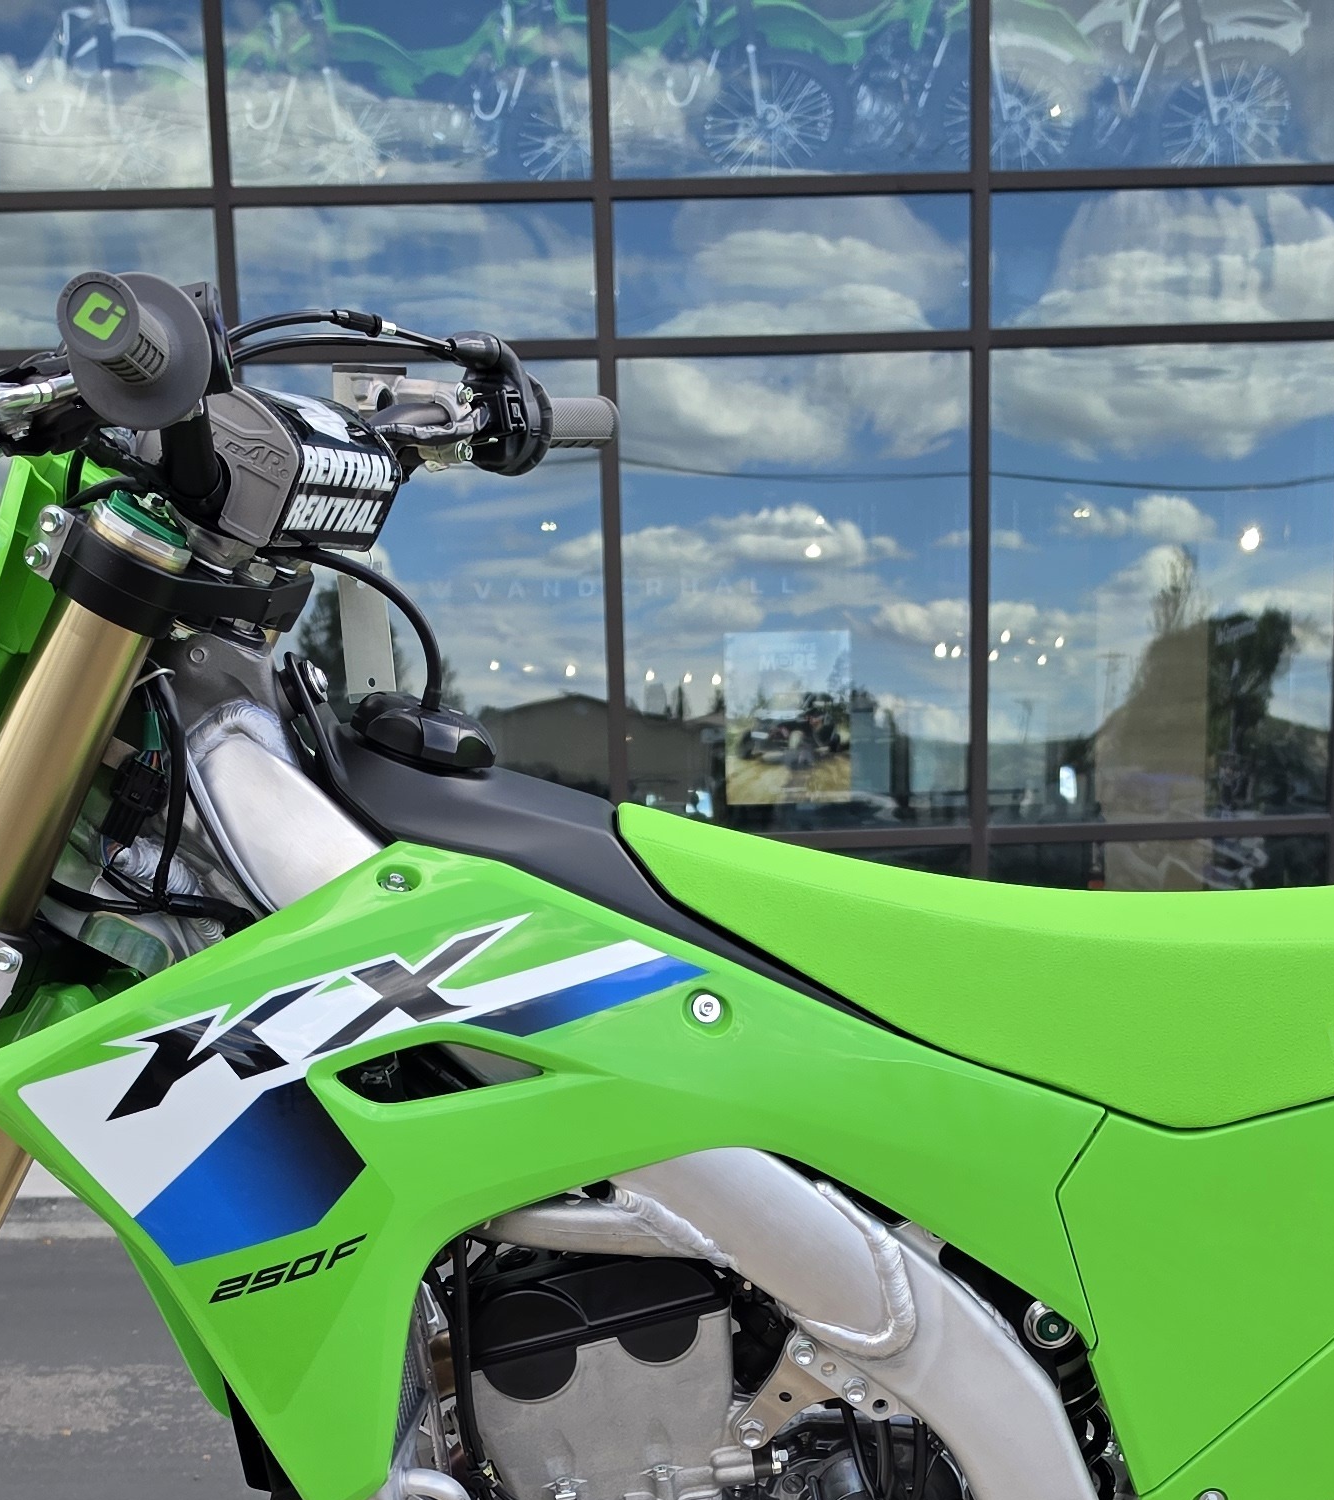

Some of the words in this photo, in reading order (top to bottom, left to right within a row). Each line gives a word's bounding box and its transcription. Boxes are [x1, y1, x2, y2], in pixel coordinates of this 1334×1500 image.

[299, 444, 397, 492] RENTHAL
[282, 494, 384, 535] RENTHAL
[473, 577, 795, 600] VANDRHALL
[106, 917, 525, 1122] KX
[208, 1234, 367, 1304] 250F
